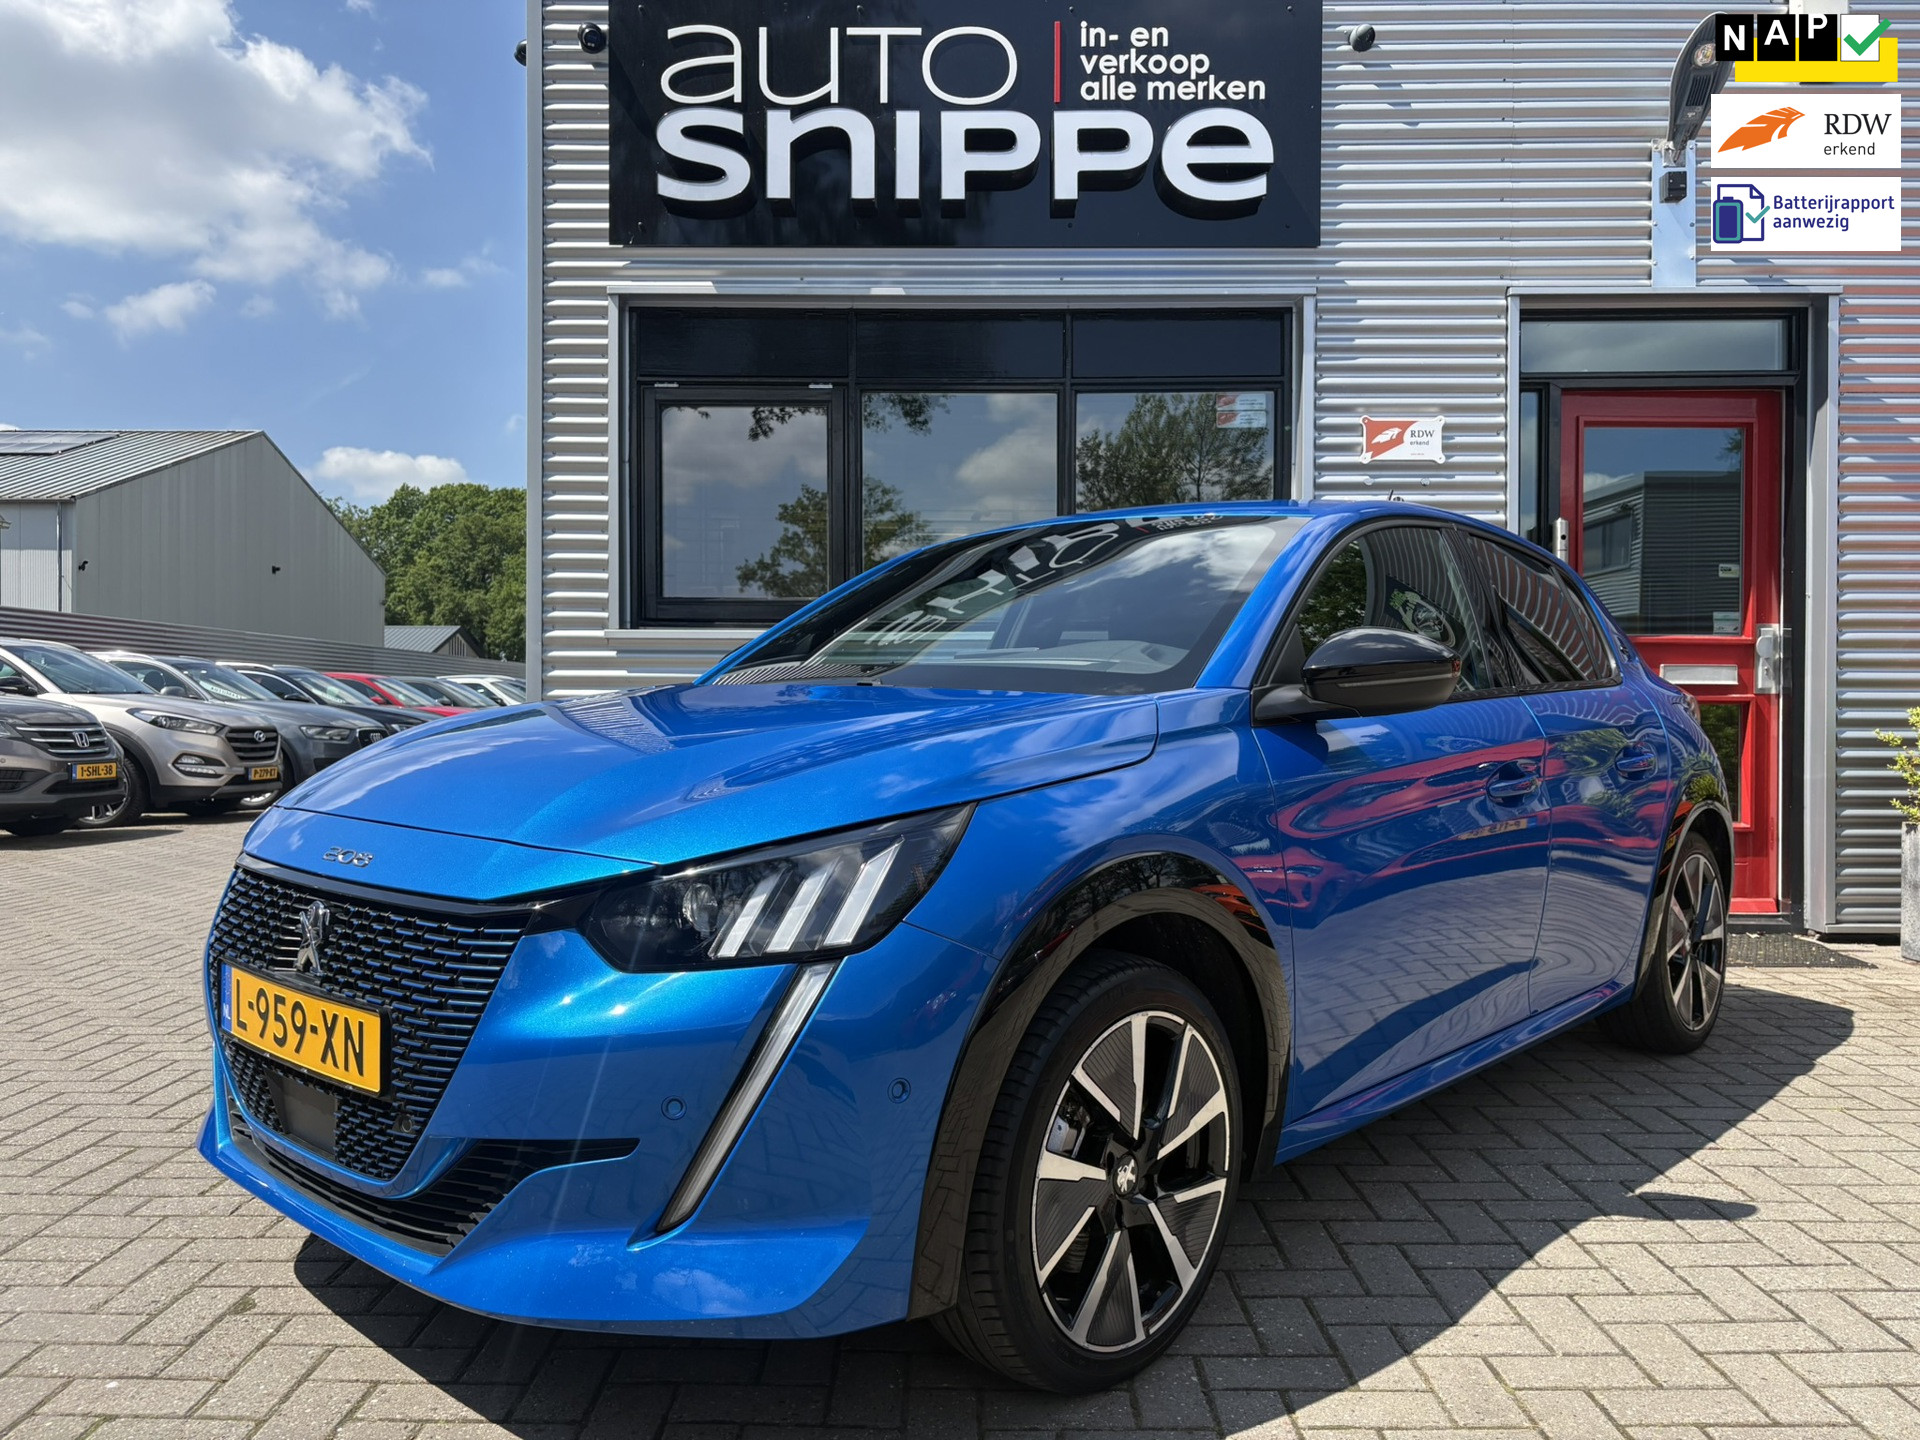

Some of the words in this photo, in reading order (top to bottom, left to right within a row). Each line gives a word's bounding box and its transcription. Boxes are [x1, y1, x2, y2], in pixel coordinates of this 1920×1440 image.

[1080, 20, 1119, 48] in-
[1130, 26, 1169, 48] en
[1079, 48, 1210, 80] verkoop
[1080, 74, 1137, 101] alle
[1147, 74, 1266, 101] merken
[1410, 429, 1435, 438] RDW
[80, 764, 113, 777] 1-SHL-38
[322, 846, 374, 868] 208
[235, 977, 365, 1078] L-959-XN
